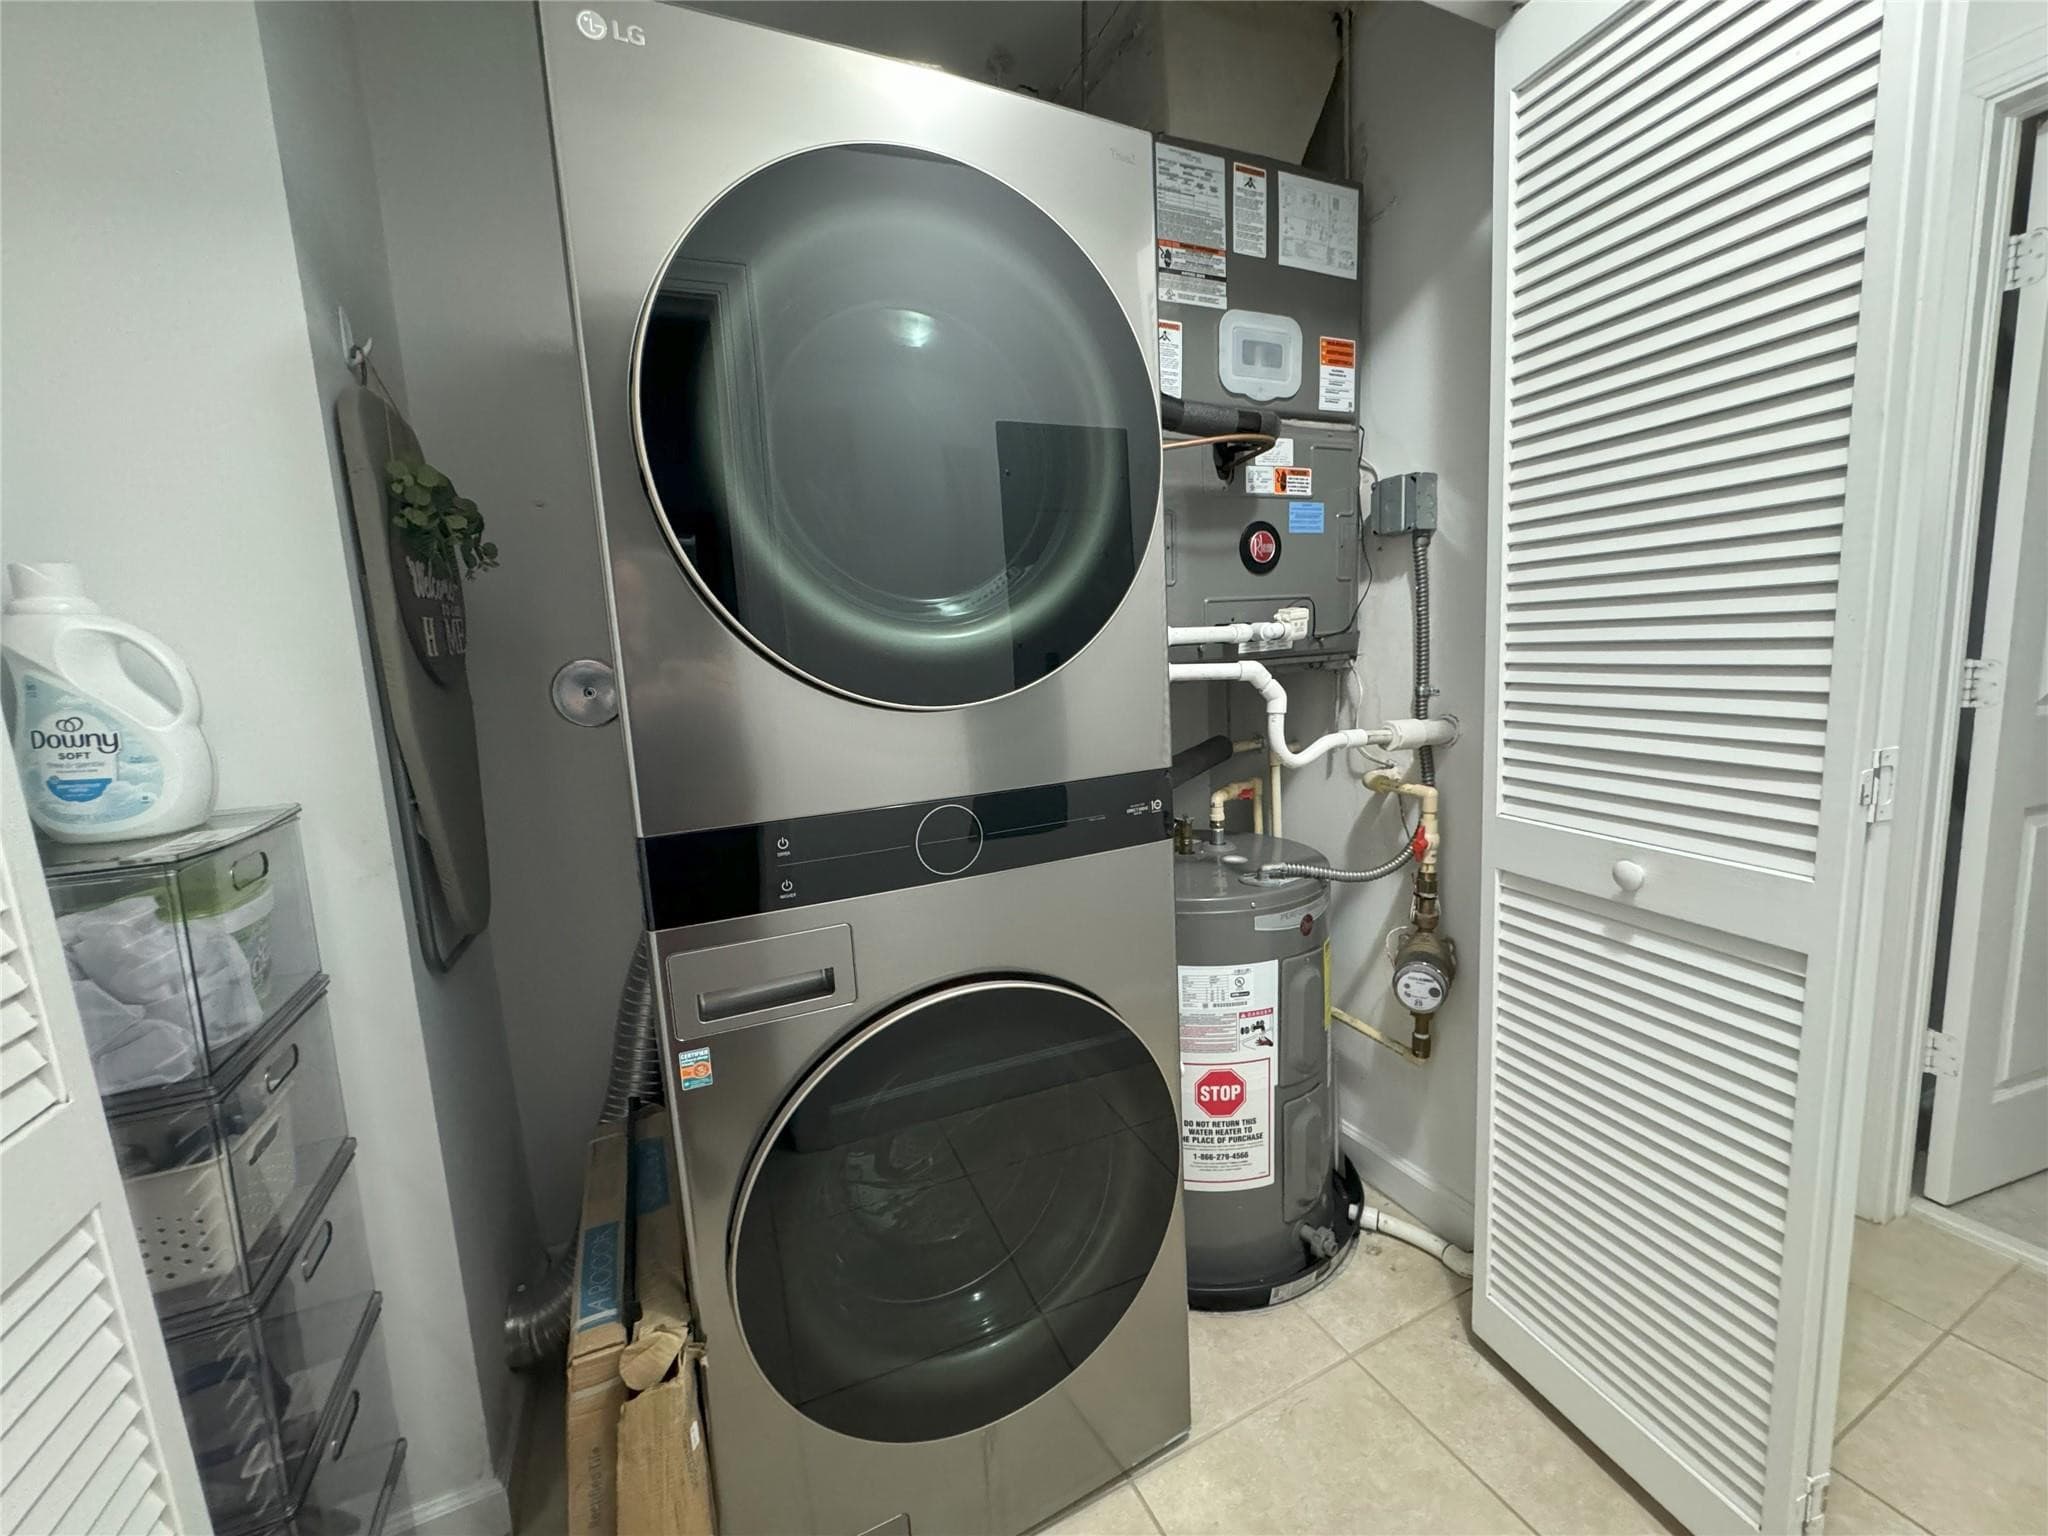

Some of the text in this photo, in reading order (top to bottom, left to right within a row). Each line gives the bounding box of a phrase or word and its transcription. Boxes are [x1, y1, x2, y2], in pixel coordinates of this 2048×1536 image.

[611, 20, 646, 46] LG
[31, 730, 119, 754] Downy
[58, 752, 91, 760] SOFT
[1200, 1085, 1241, 1102] STOP
[1184, 1117, 1257, 1128] DO NOT RETURN THIS
[1188, 1128, 1213, 1136] WATER
[1215, 1128, 1242, 1136] HEATER
[1192, 1136, 1216, 1144] PLACE
[1217, 1136, 1226, 1144] OF
[1228, 1132, 1264, 1144] PURCHASE
